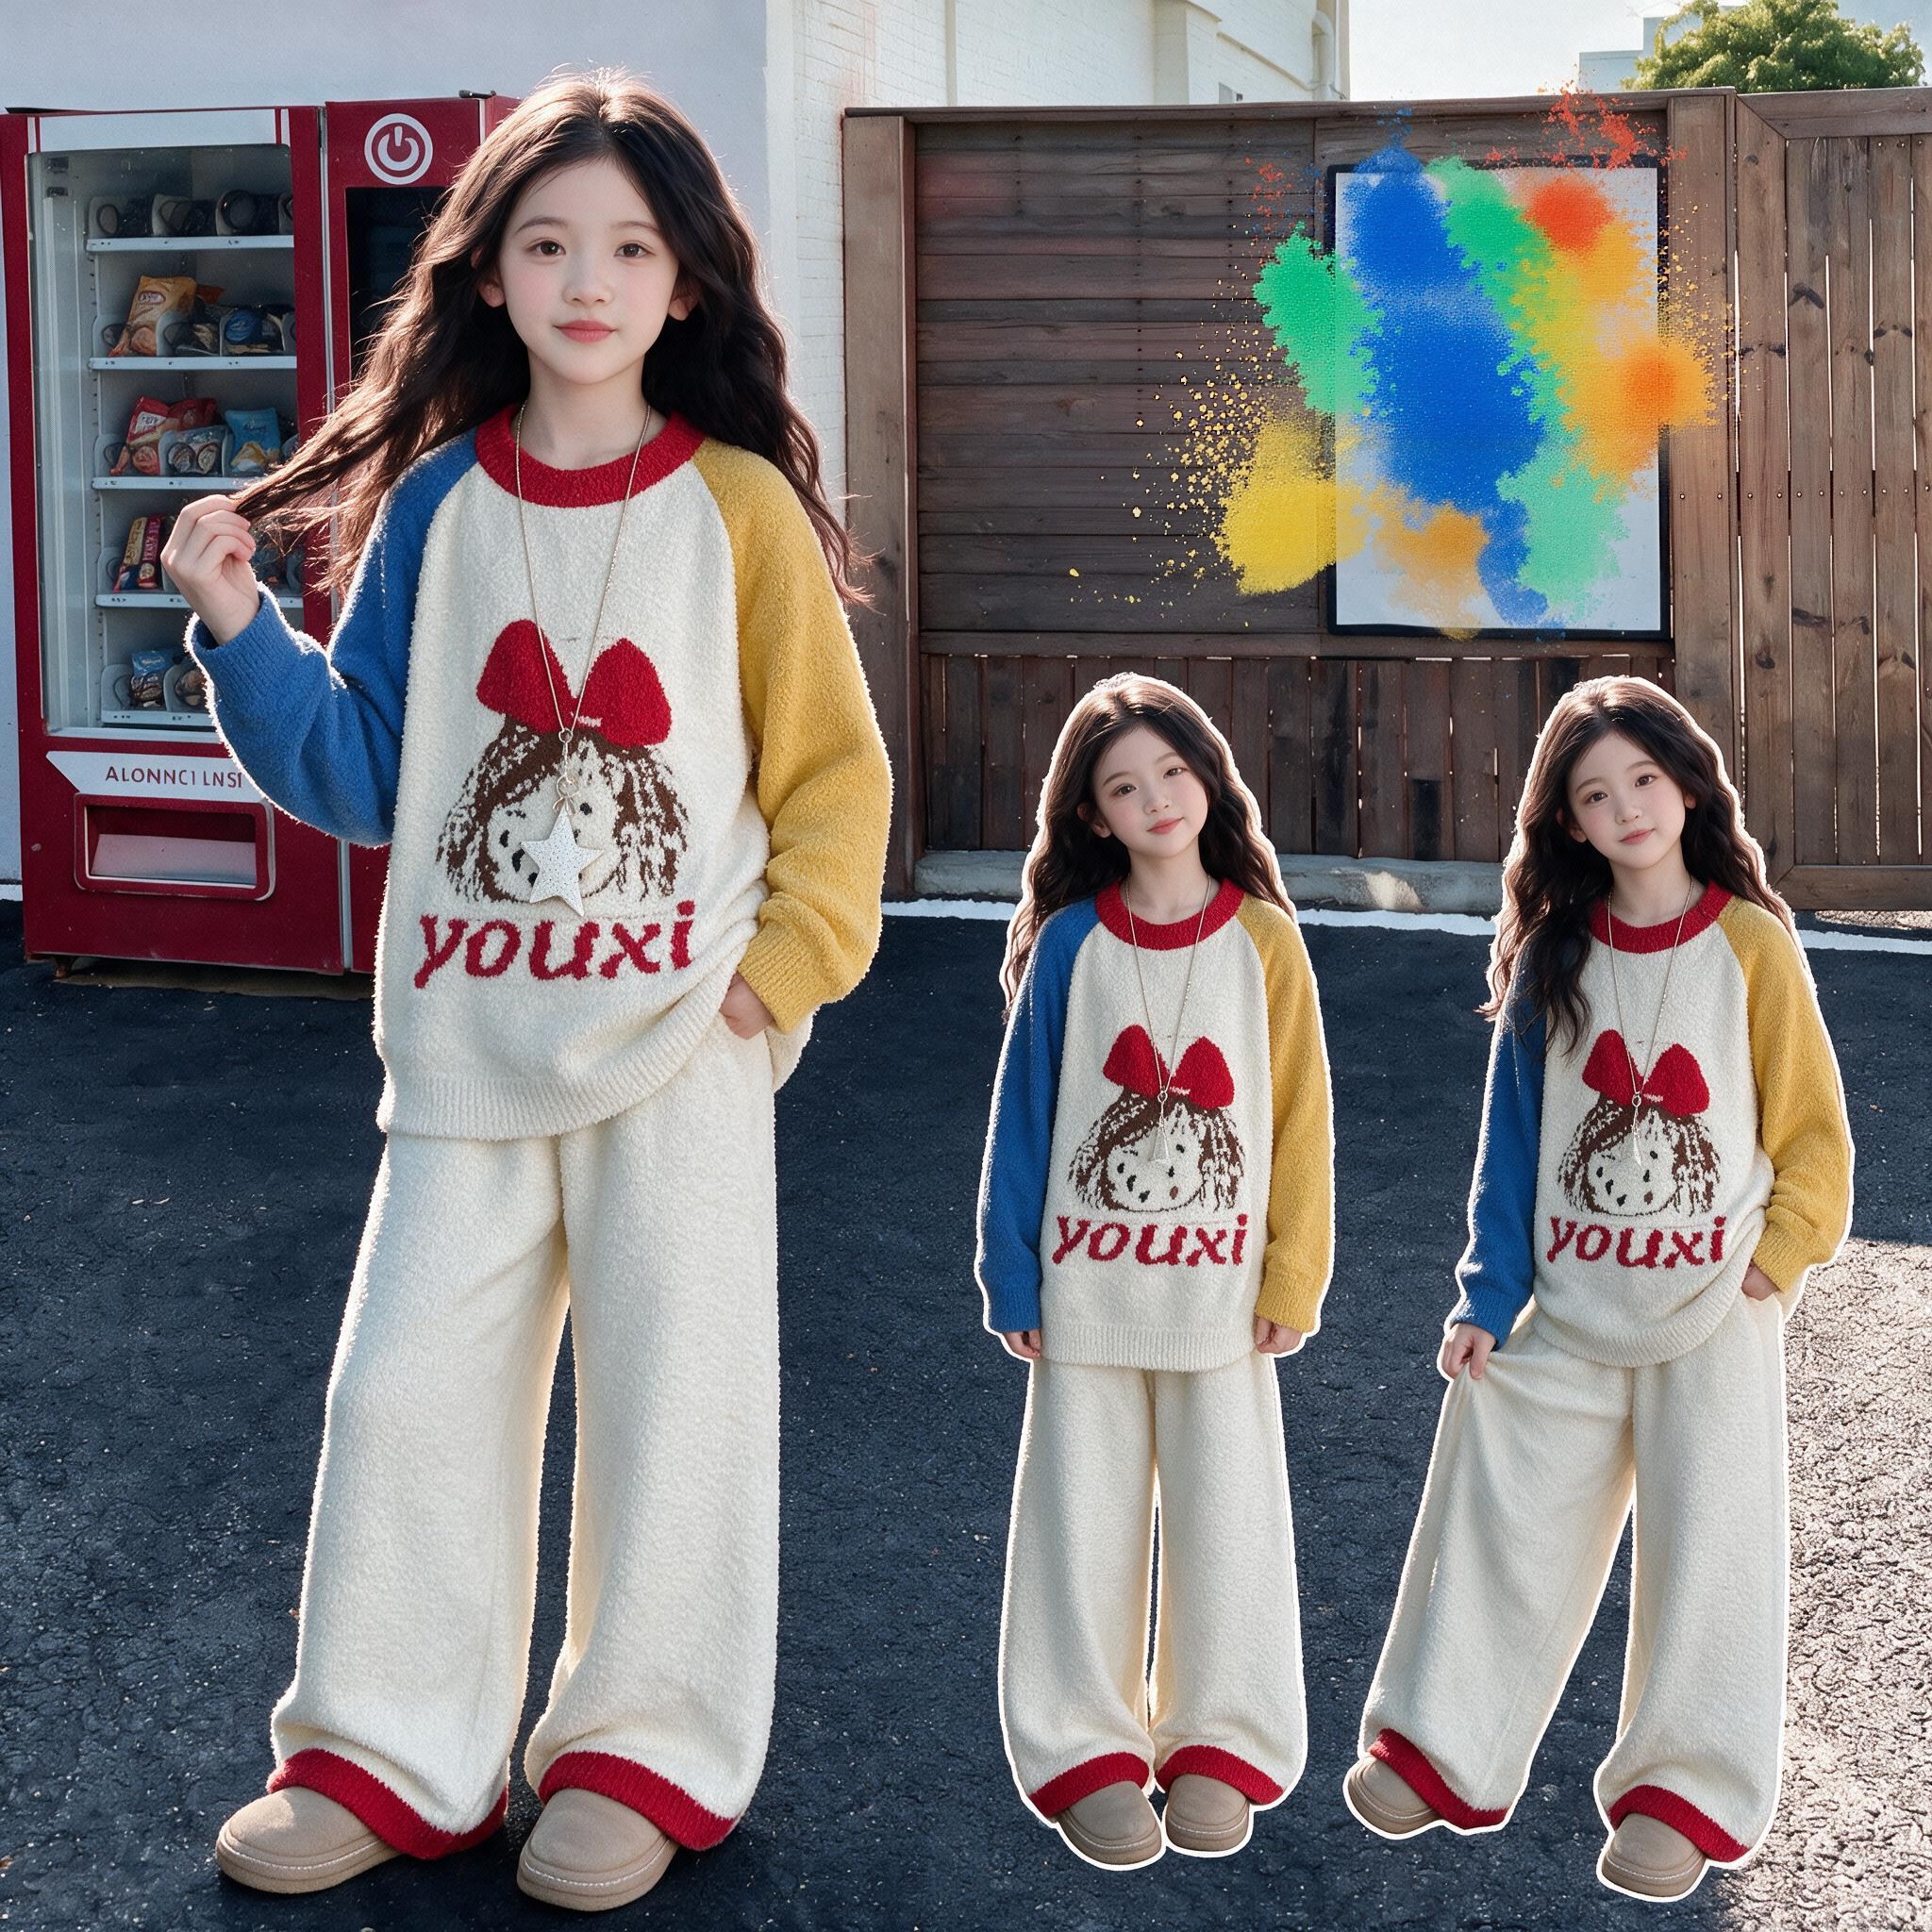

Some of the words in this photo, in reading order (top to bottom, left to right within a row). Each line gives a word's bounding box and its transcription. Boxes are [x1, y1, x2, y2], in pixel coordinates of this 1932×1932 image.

[413, 899, 696, 990] youxi
[1051, 1213, 1249, 1267] youxi
[1546, 1215, 1727, 1269] youxi
